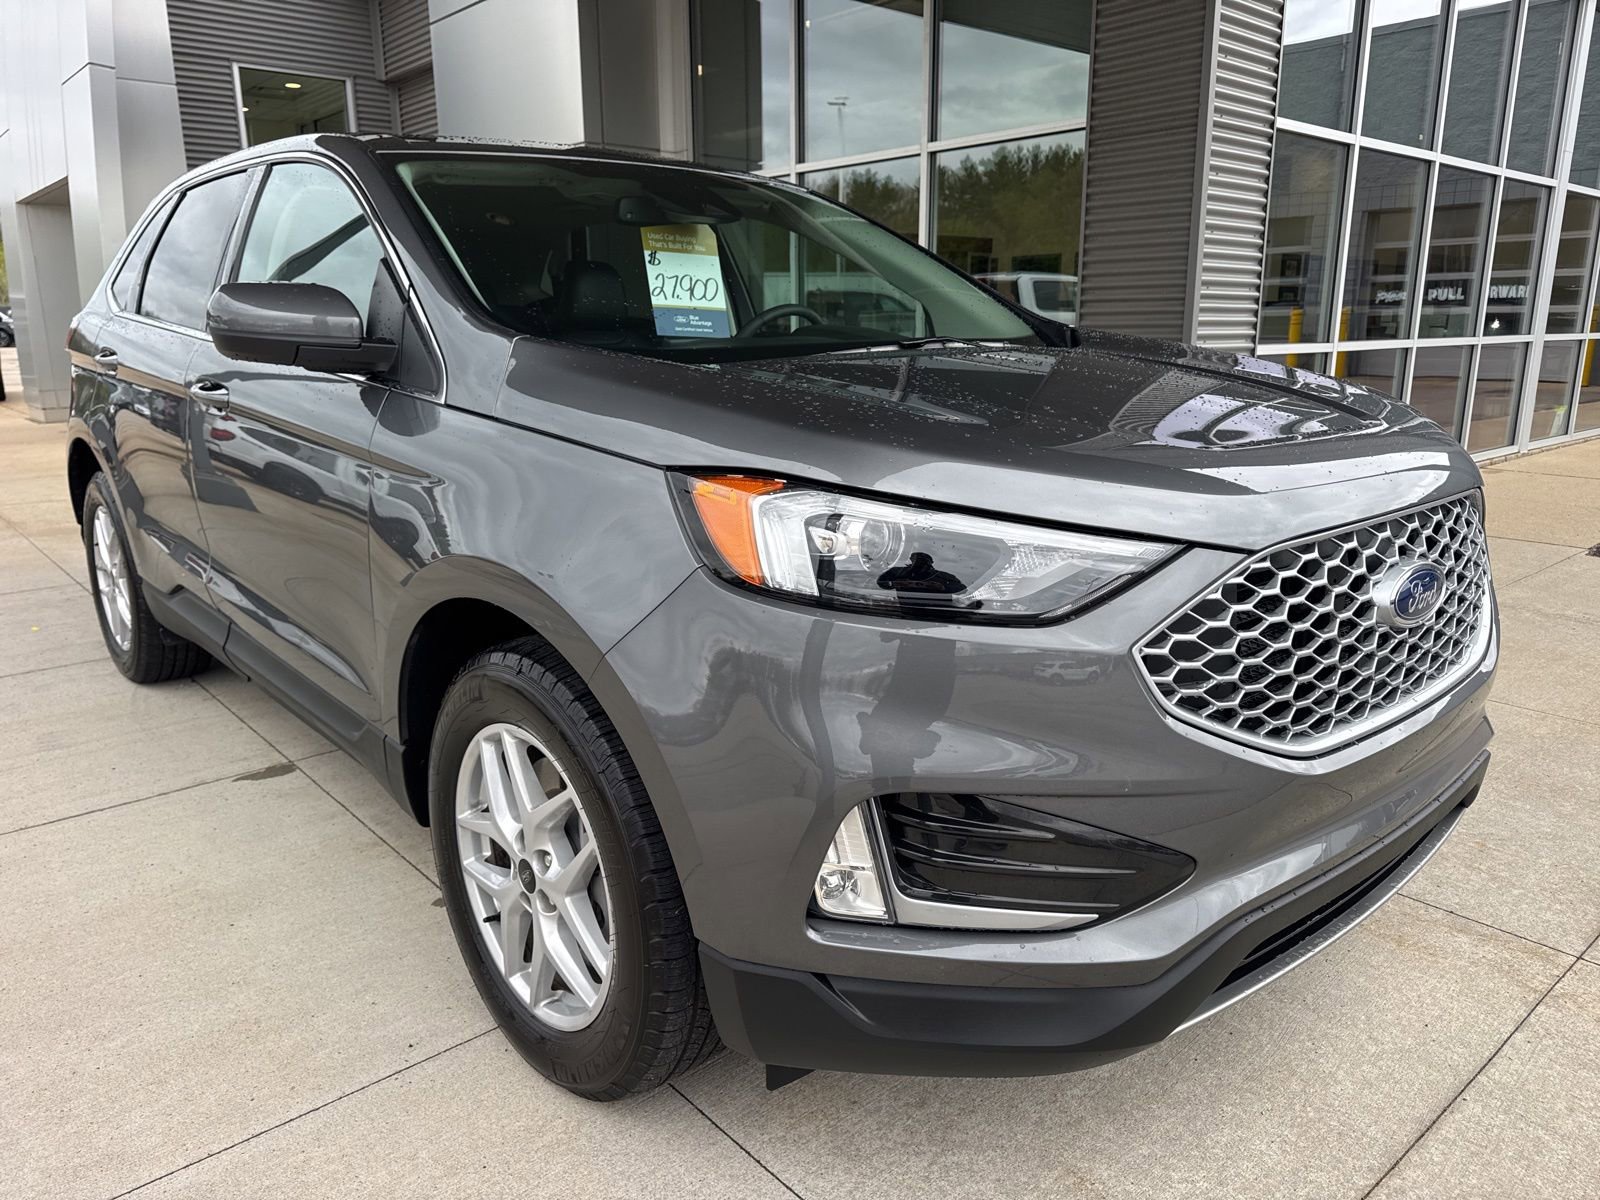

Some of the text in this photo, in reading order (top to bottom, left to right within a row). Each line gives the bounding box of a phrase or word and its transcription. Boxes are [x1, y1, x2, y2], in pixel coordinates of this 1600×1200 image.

[648, 250, 661, 266] $
[1427, 287, 1464, 301] PULL
[1408, 577, 1437, 613] Ford
